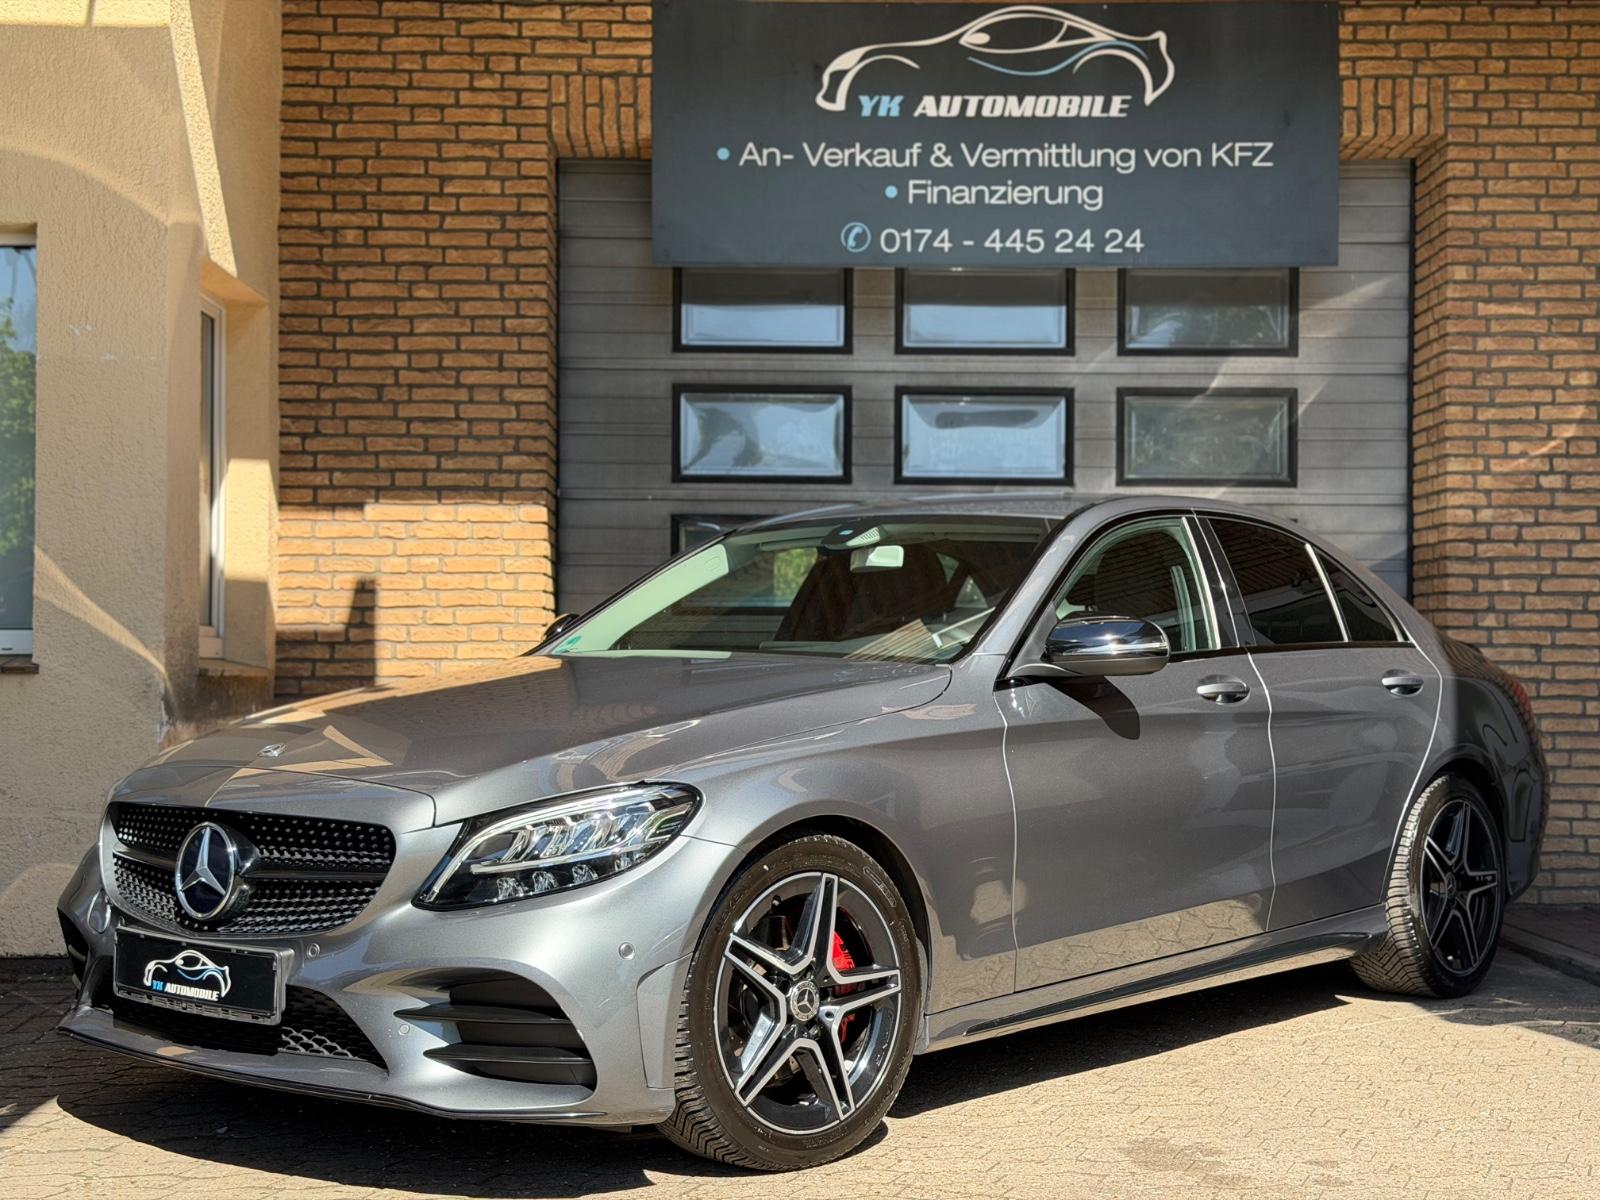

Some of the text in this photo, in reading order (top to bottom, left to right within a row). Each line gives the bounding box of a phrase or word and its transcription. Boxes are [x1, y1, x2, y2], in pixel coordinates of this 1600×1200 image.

[859, 96, 1132, 117] YK AUTOMOBILE
[740, 142, 1273, 174] An- Verkauf & Vermittlung von KFZ
[909, 180, 1104, 211] Finanzierung
[880, 228, 953, 254] 0174
[984, 229, 1045, 254] 445
[1055, 229, 1095, 254] 24
[1105, 229, 1145, 254] 24
[164, 982, 219, 1001] AUTOMOBILE
